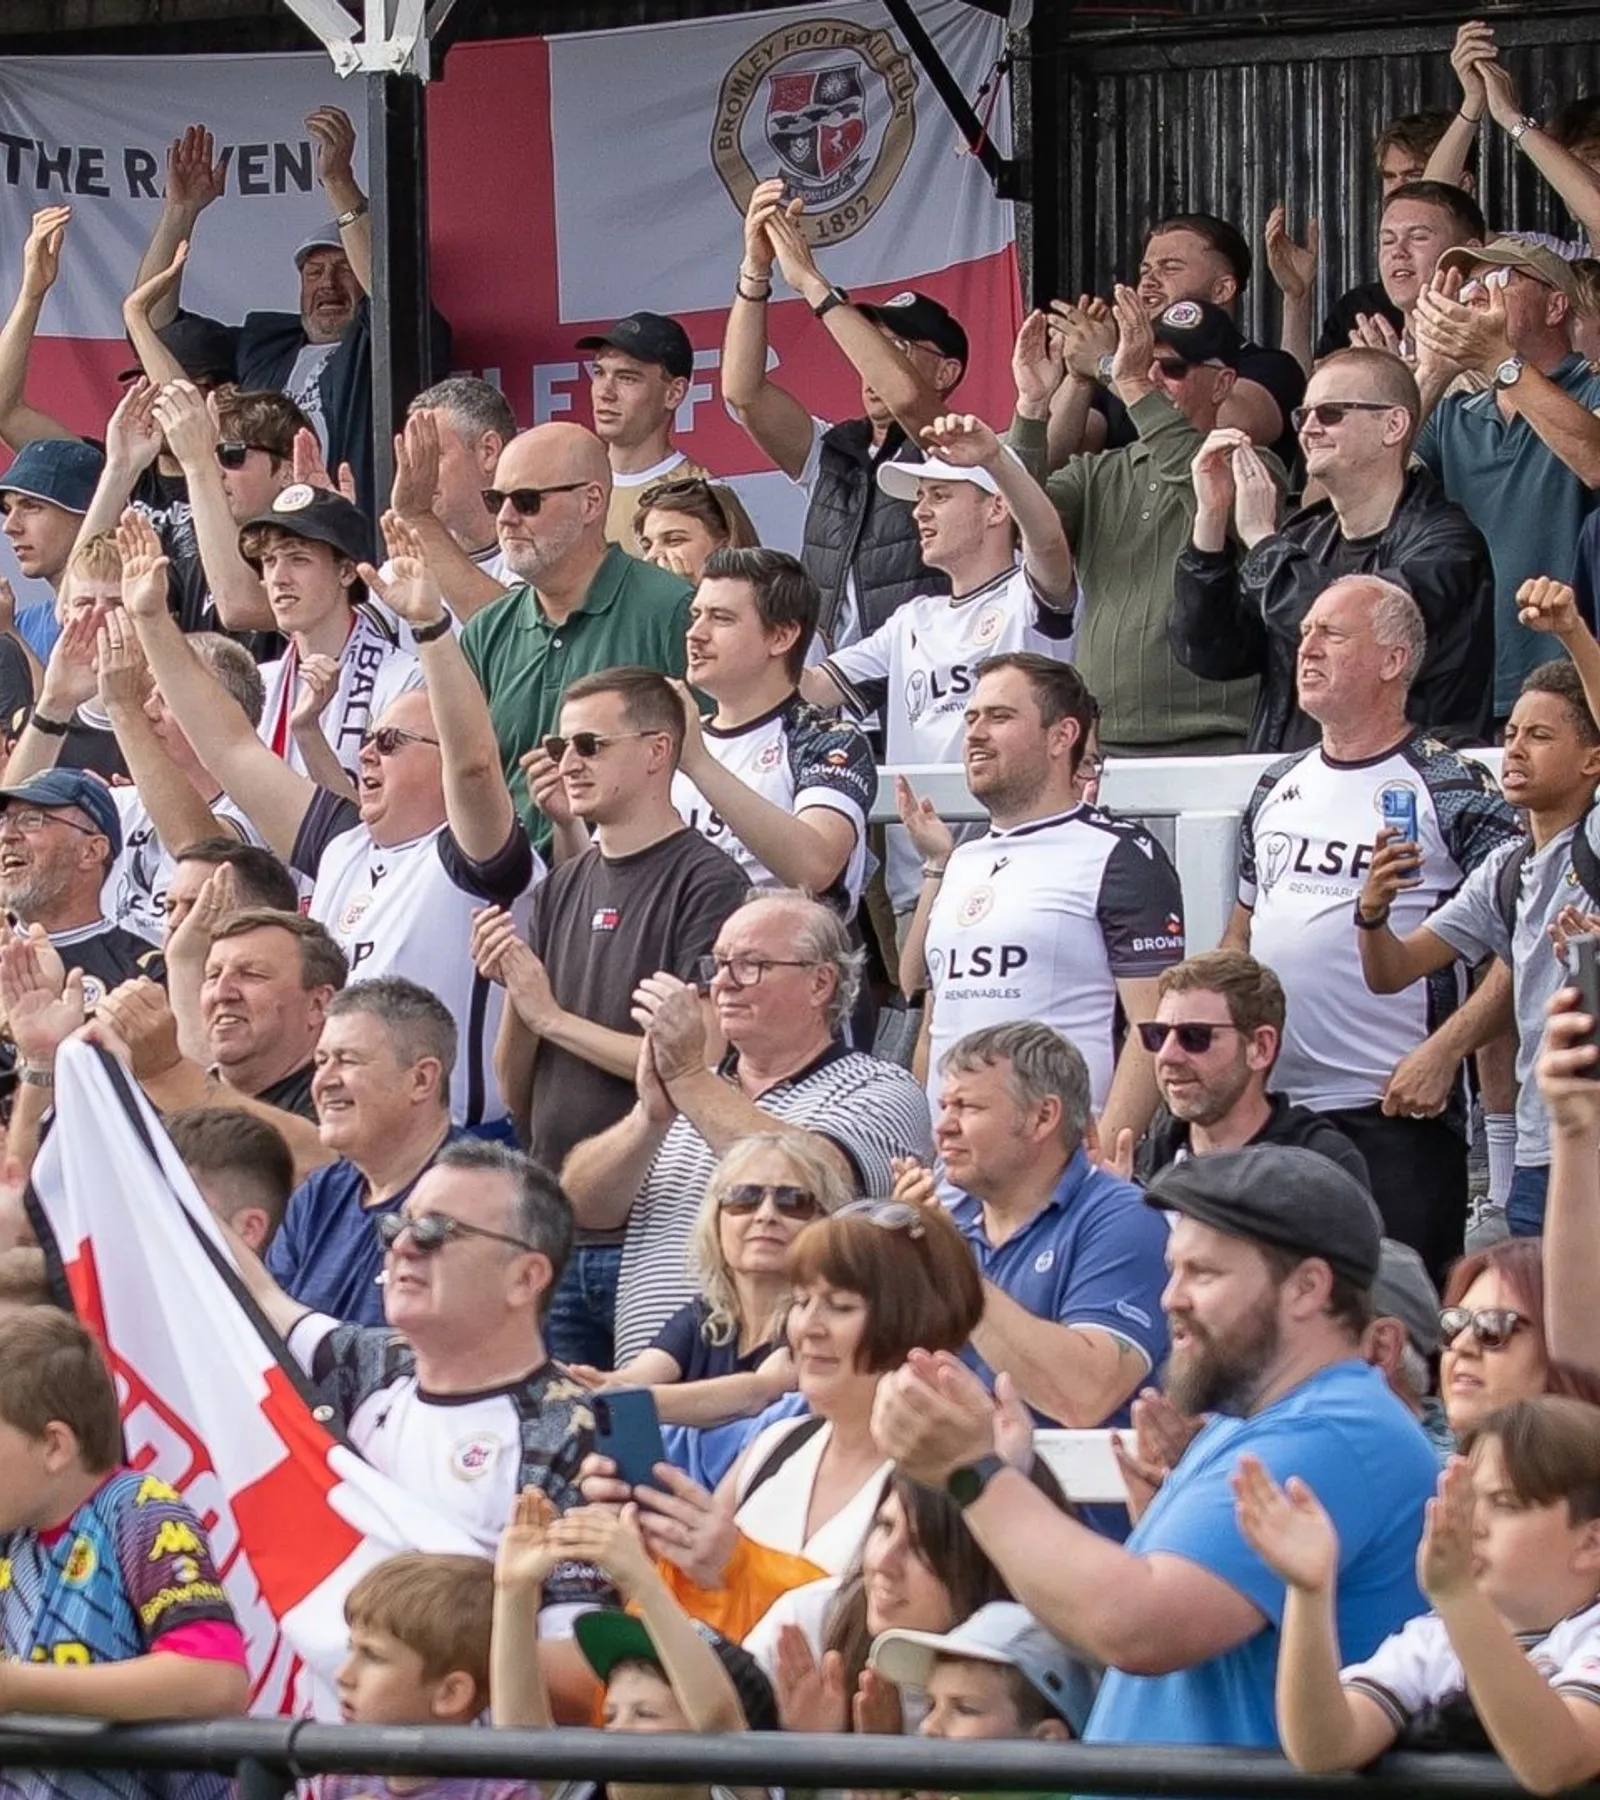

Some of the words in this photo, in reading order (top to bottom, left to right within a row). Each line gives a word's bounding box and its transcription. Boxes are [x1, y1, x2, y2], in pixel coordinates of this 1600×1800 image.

[718, 45, 775, 150] BROMLEY
[784, 26, 885, 60] FOOTBALL
[123, 141, 325, 199] RVEN
[817, 196, 873, 239] 1892
[930, 664, 972, 699] LS
[948, 945, 1028, 979] LSP
[945, 987, 1022, 1000] RENEWABLES
